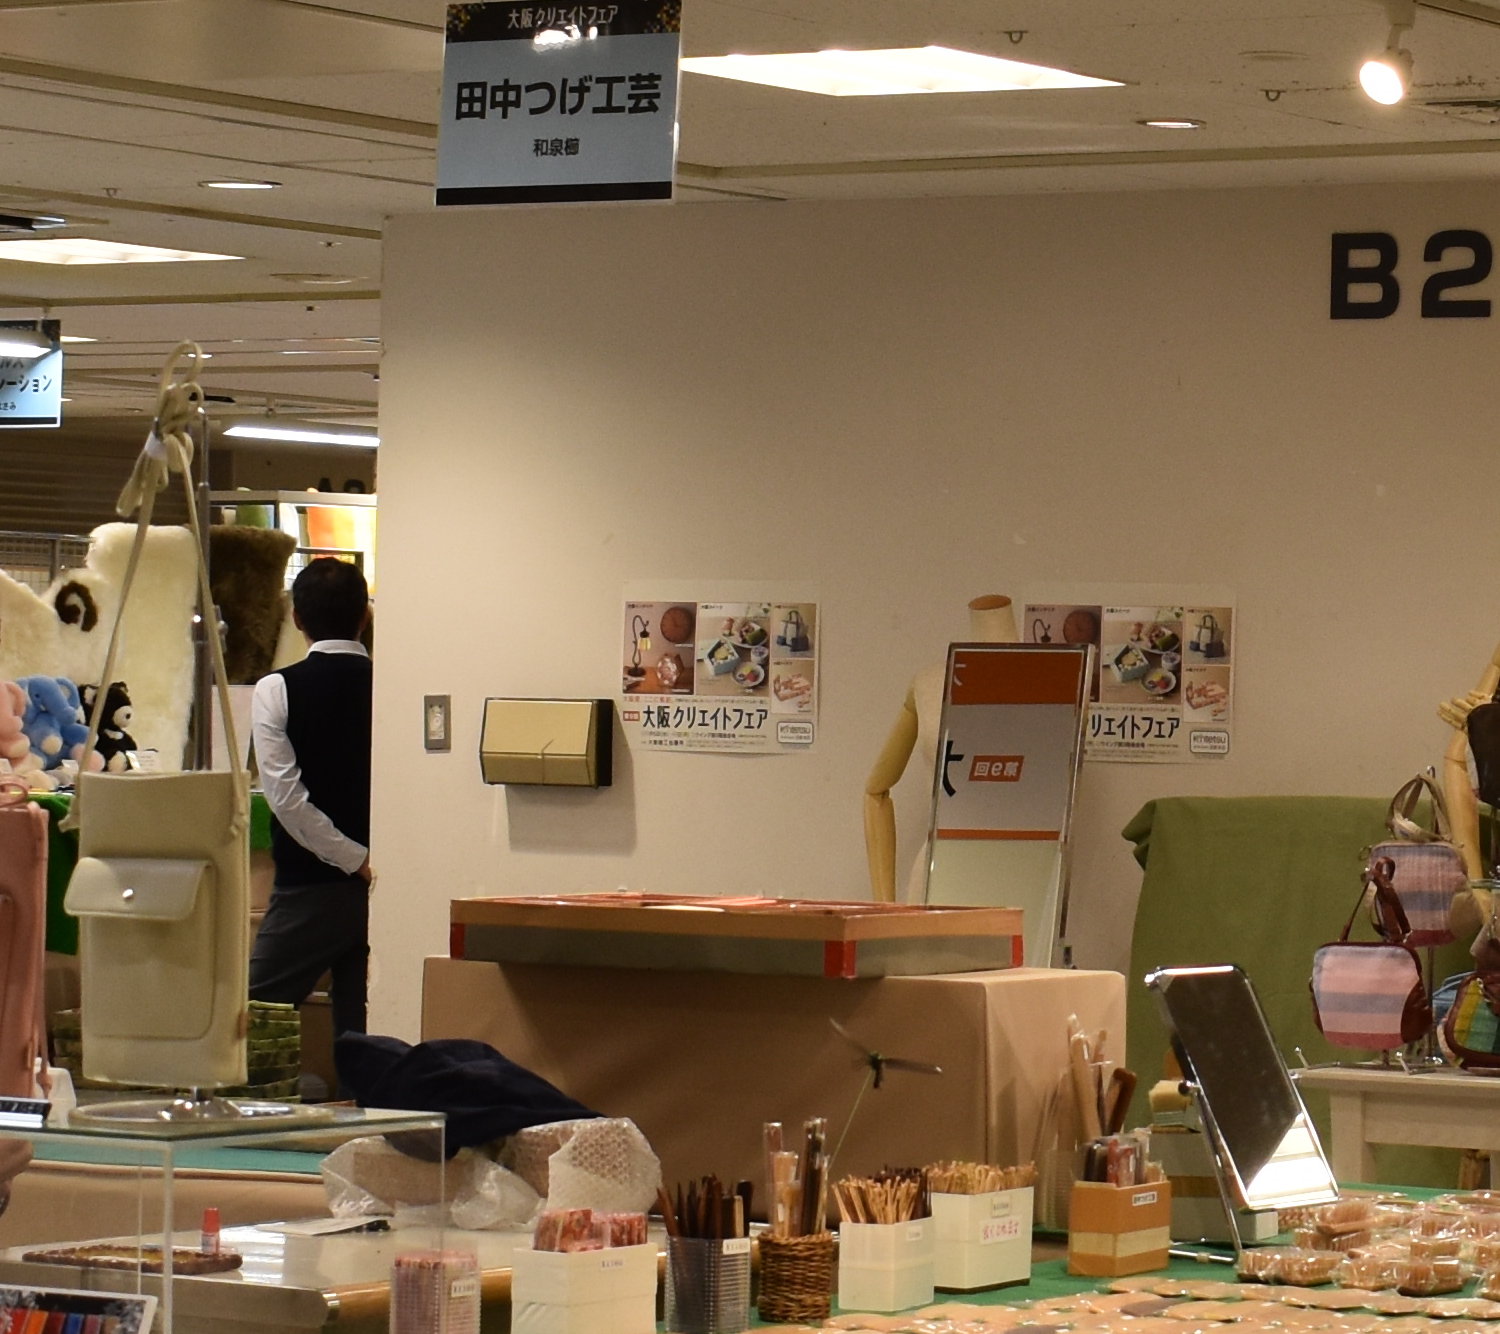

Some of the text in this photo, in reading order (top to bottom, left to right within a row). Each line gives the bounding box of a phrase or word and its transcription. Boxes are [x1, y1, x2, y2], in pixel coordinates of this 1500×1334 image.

[455, 72, 662, 120] 田中つげ工芸
[1331, 229, 1493, 321] B2
[642, 704, 768, 731] 大阪クリエイトフェア
